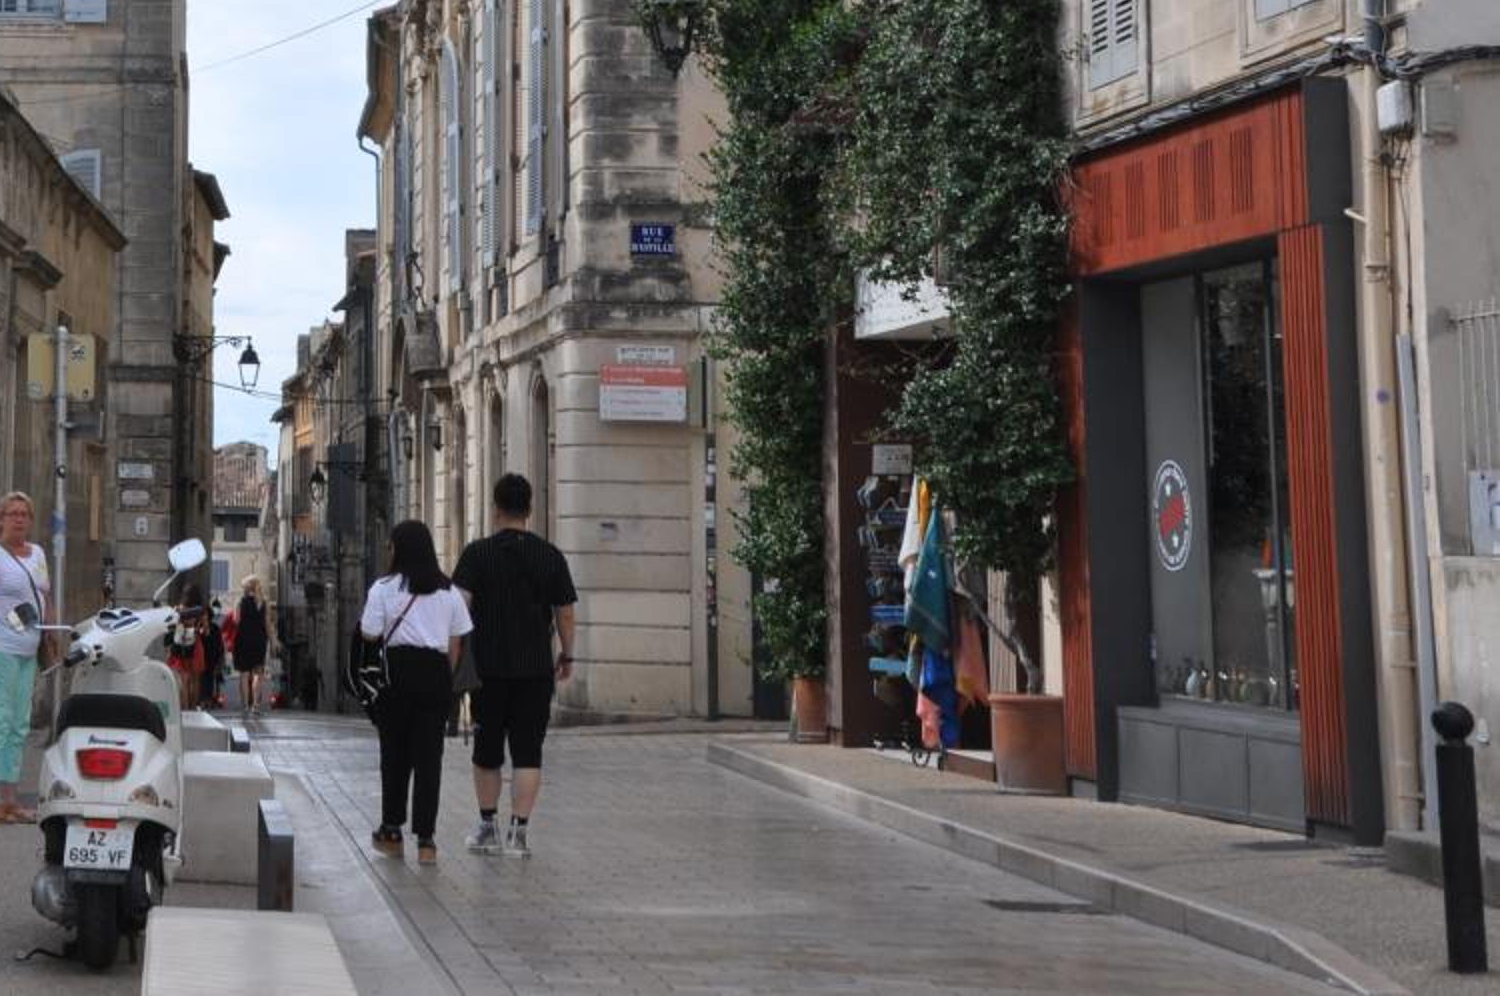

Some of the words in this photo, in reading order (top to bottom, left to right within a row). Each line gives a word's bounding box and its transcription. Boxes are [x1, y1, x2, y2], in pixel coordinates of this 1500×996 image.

[88, 831, 106, 846] AZ
[69, 847, 98, 862] 695
[108, 850, 126, 864] VF
